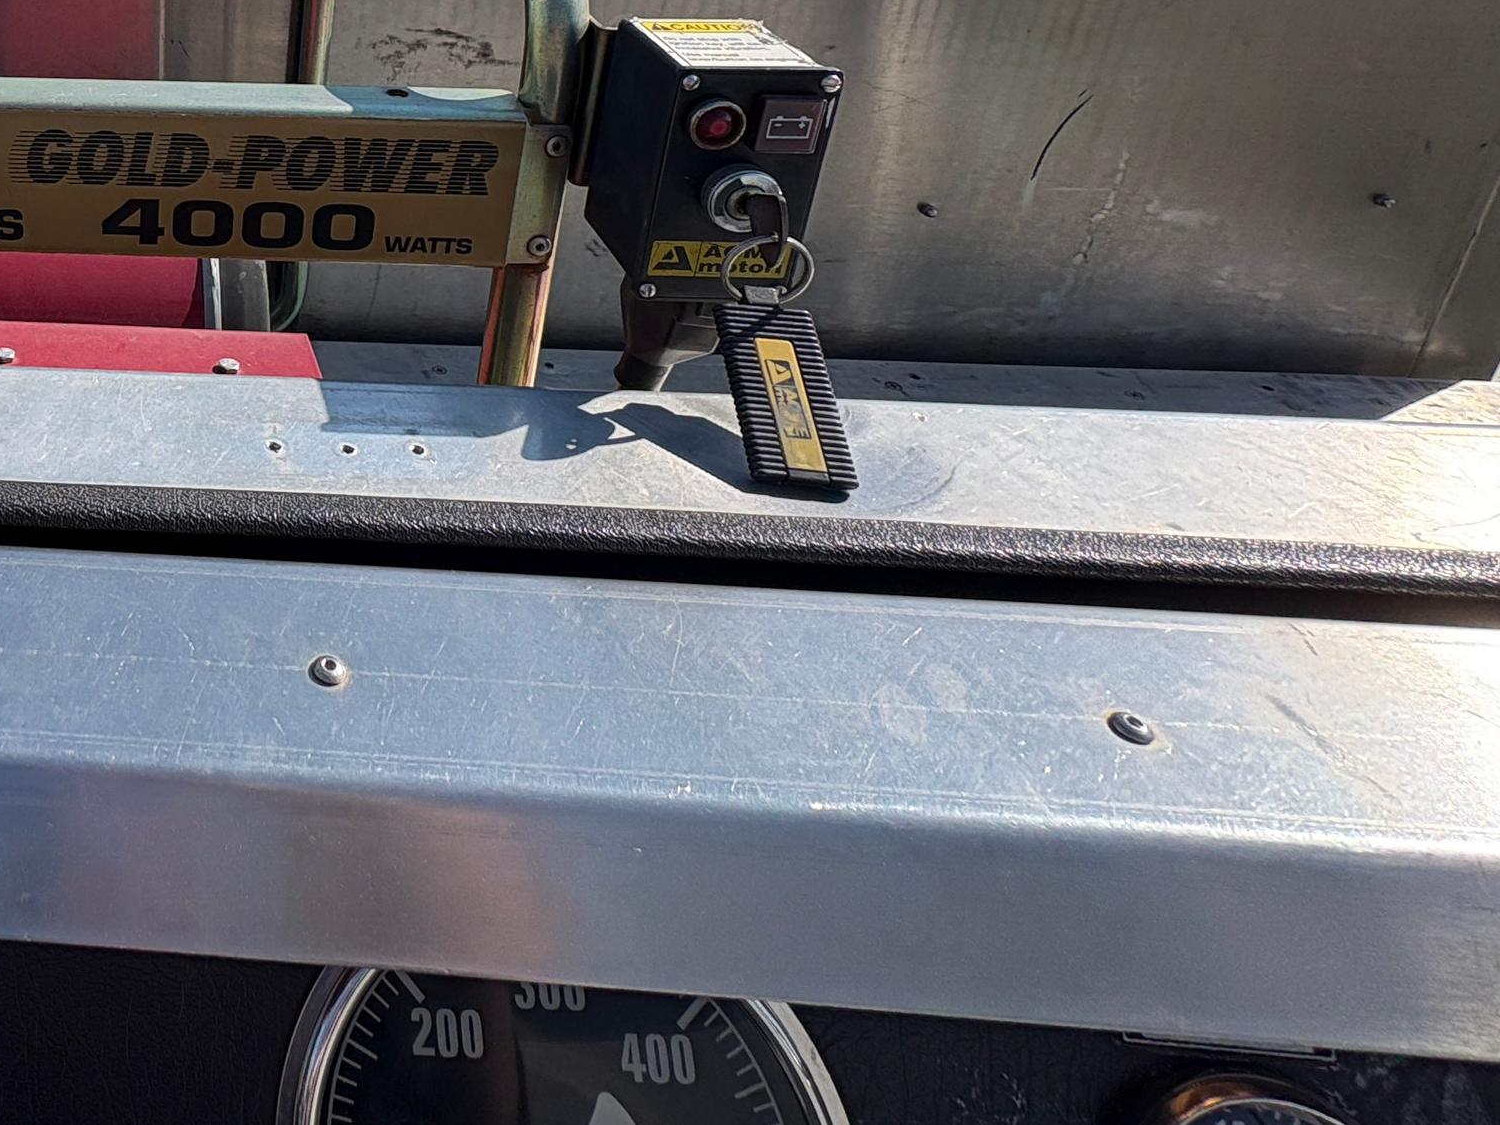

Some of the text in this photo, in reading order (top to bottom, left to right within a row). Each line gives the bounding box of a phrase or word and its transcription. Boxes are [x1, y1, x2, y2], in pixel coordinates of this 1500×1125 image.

[8, 128, 499, 196] GOLD-POWER
[101, 198, 473, 255] 4000 WATTS
[410, 1006, 484, 1060] 200
[621, 1031, 696, 1085] 400
